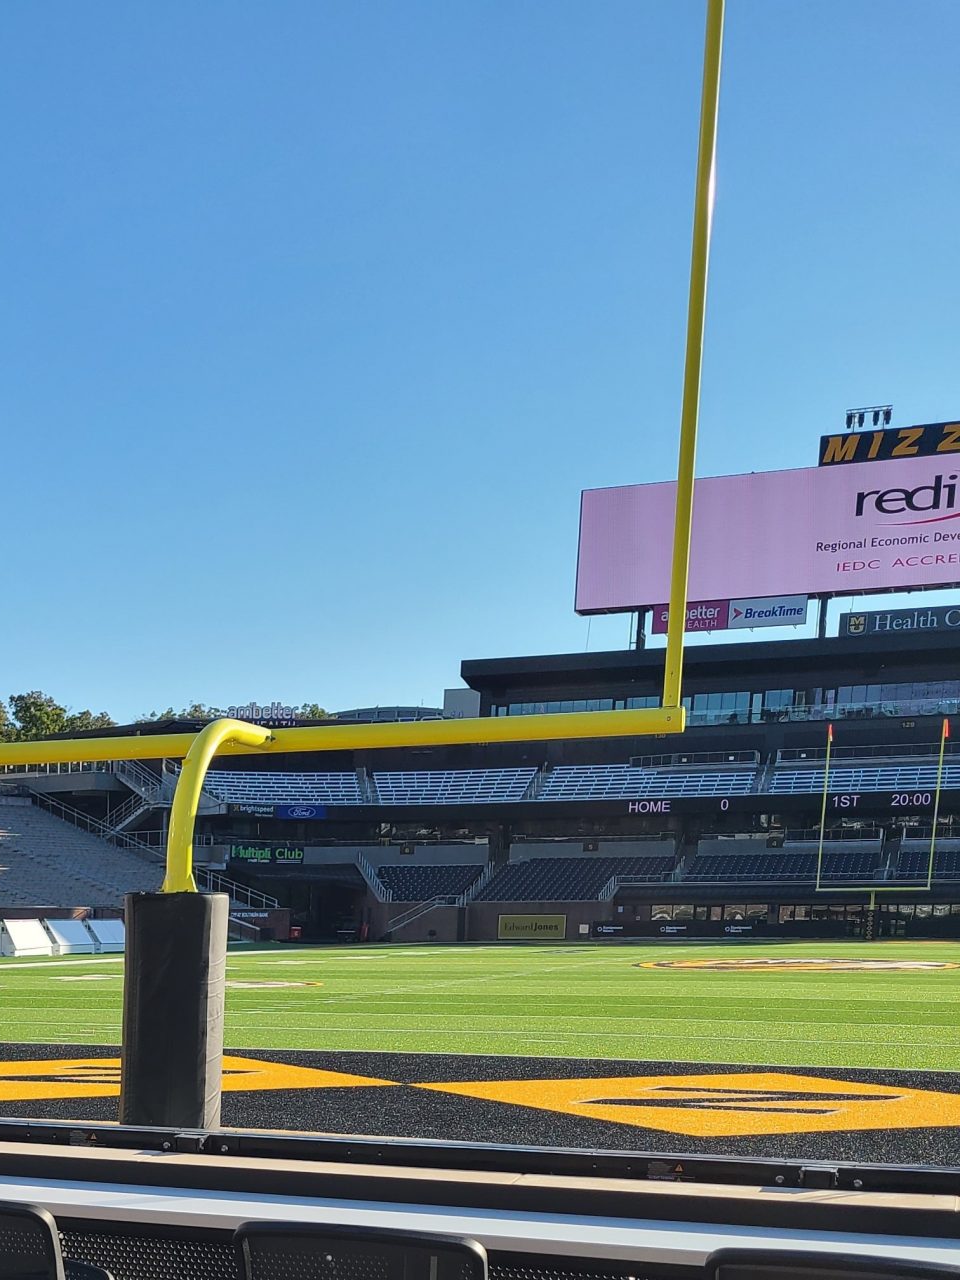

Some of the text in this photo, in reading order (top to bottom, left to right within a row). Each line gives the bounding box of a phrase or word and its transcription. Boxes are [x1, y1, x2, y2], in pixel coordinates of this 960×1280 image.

[855, 474, 958, 516] redi
[816, 538, 867, 553] Regional
[871, 533, 930, 548] Economic
[836, 553, 960, 572] IEDC ACCRE
[744, 605, 804, 619] BreakTime
[873, 610, 938, 631] Health
[687, 619, 718, 629] EALTH
[227, 702, 299, 719] ambetter
[628, 793, 931, 813] HOME 0 1ST 20:00
[275, 847, 303, 859] Club
